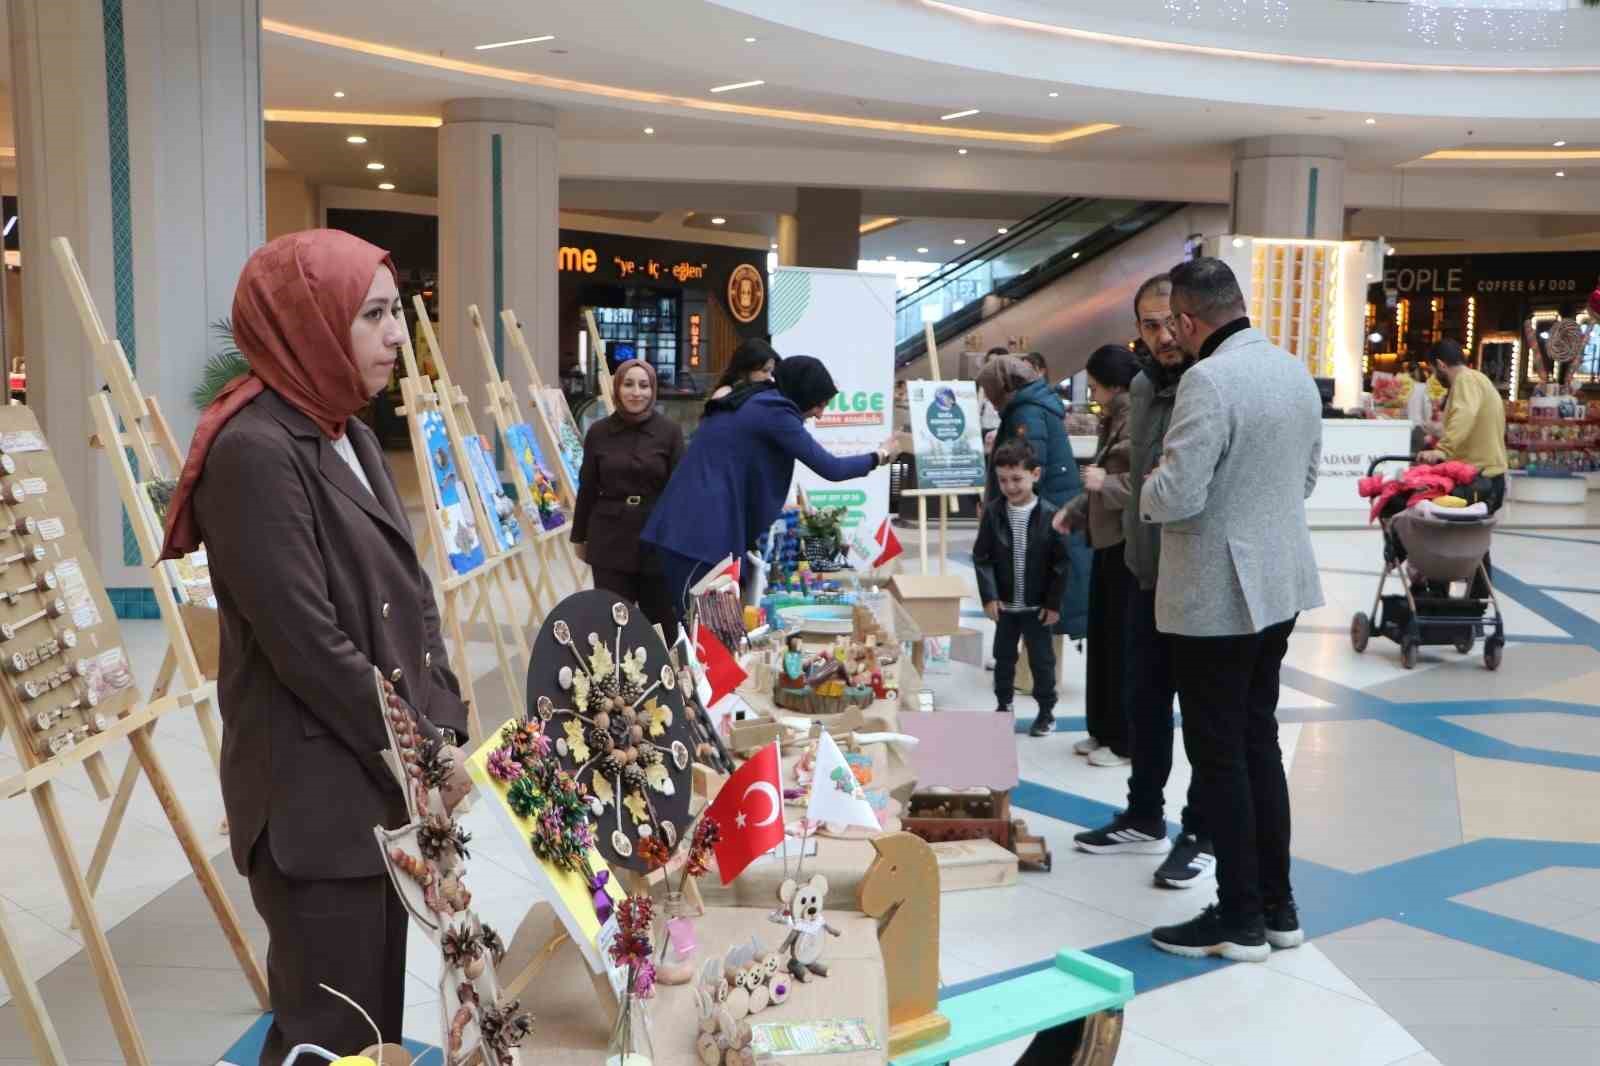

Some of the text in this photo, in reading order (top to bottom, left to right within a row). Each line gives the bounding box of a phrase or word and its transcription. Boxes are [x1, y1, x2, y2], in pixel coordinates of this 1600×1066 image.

[1382, 268, 1463, 292] EOPLE
[1477, 280, 1524, 291] COFFEE
[1321, 453, 1361, 464] ADAME
